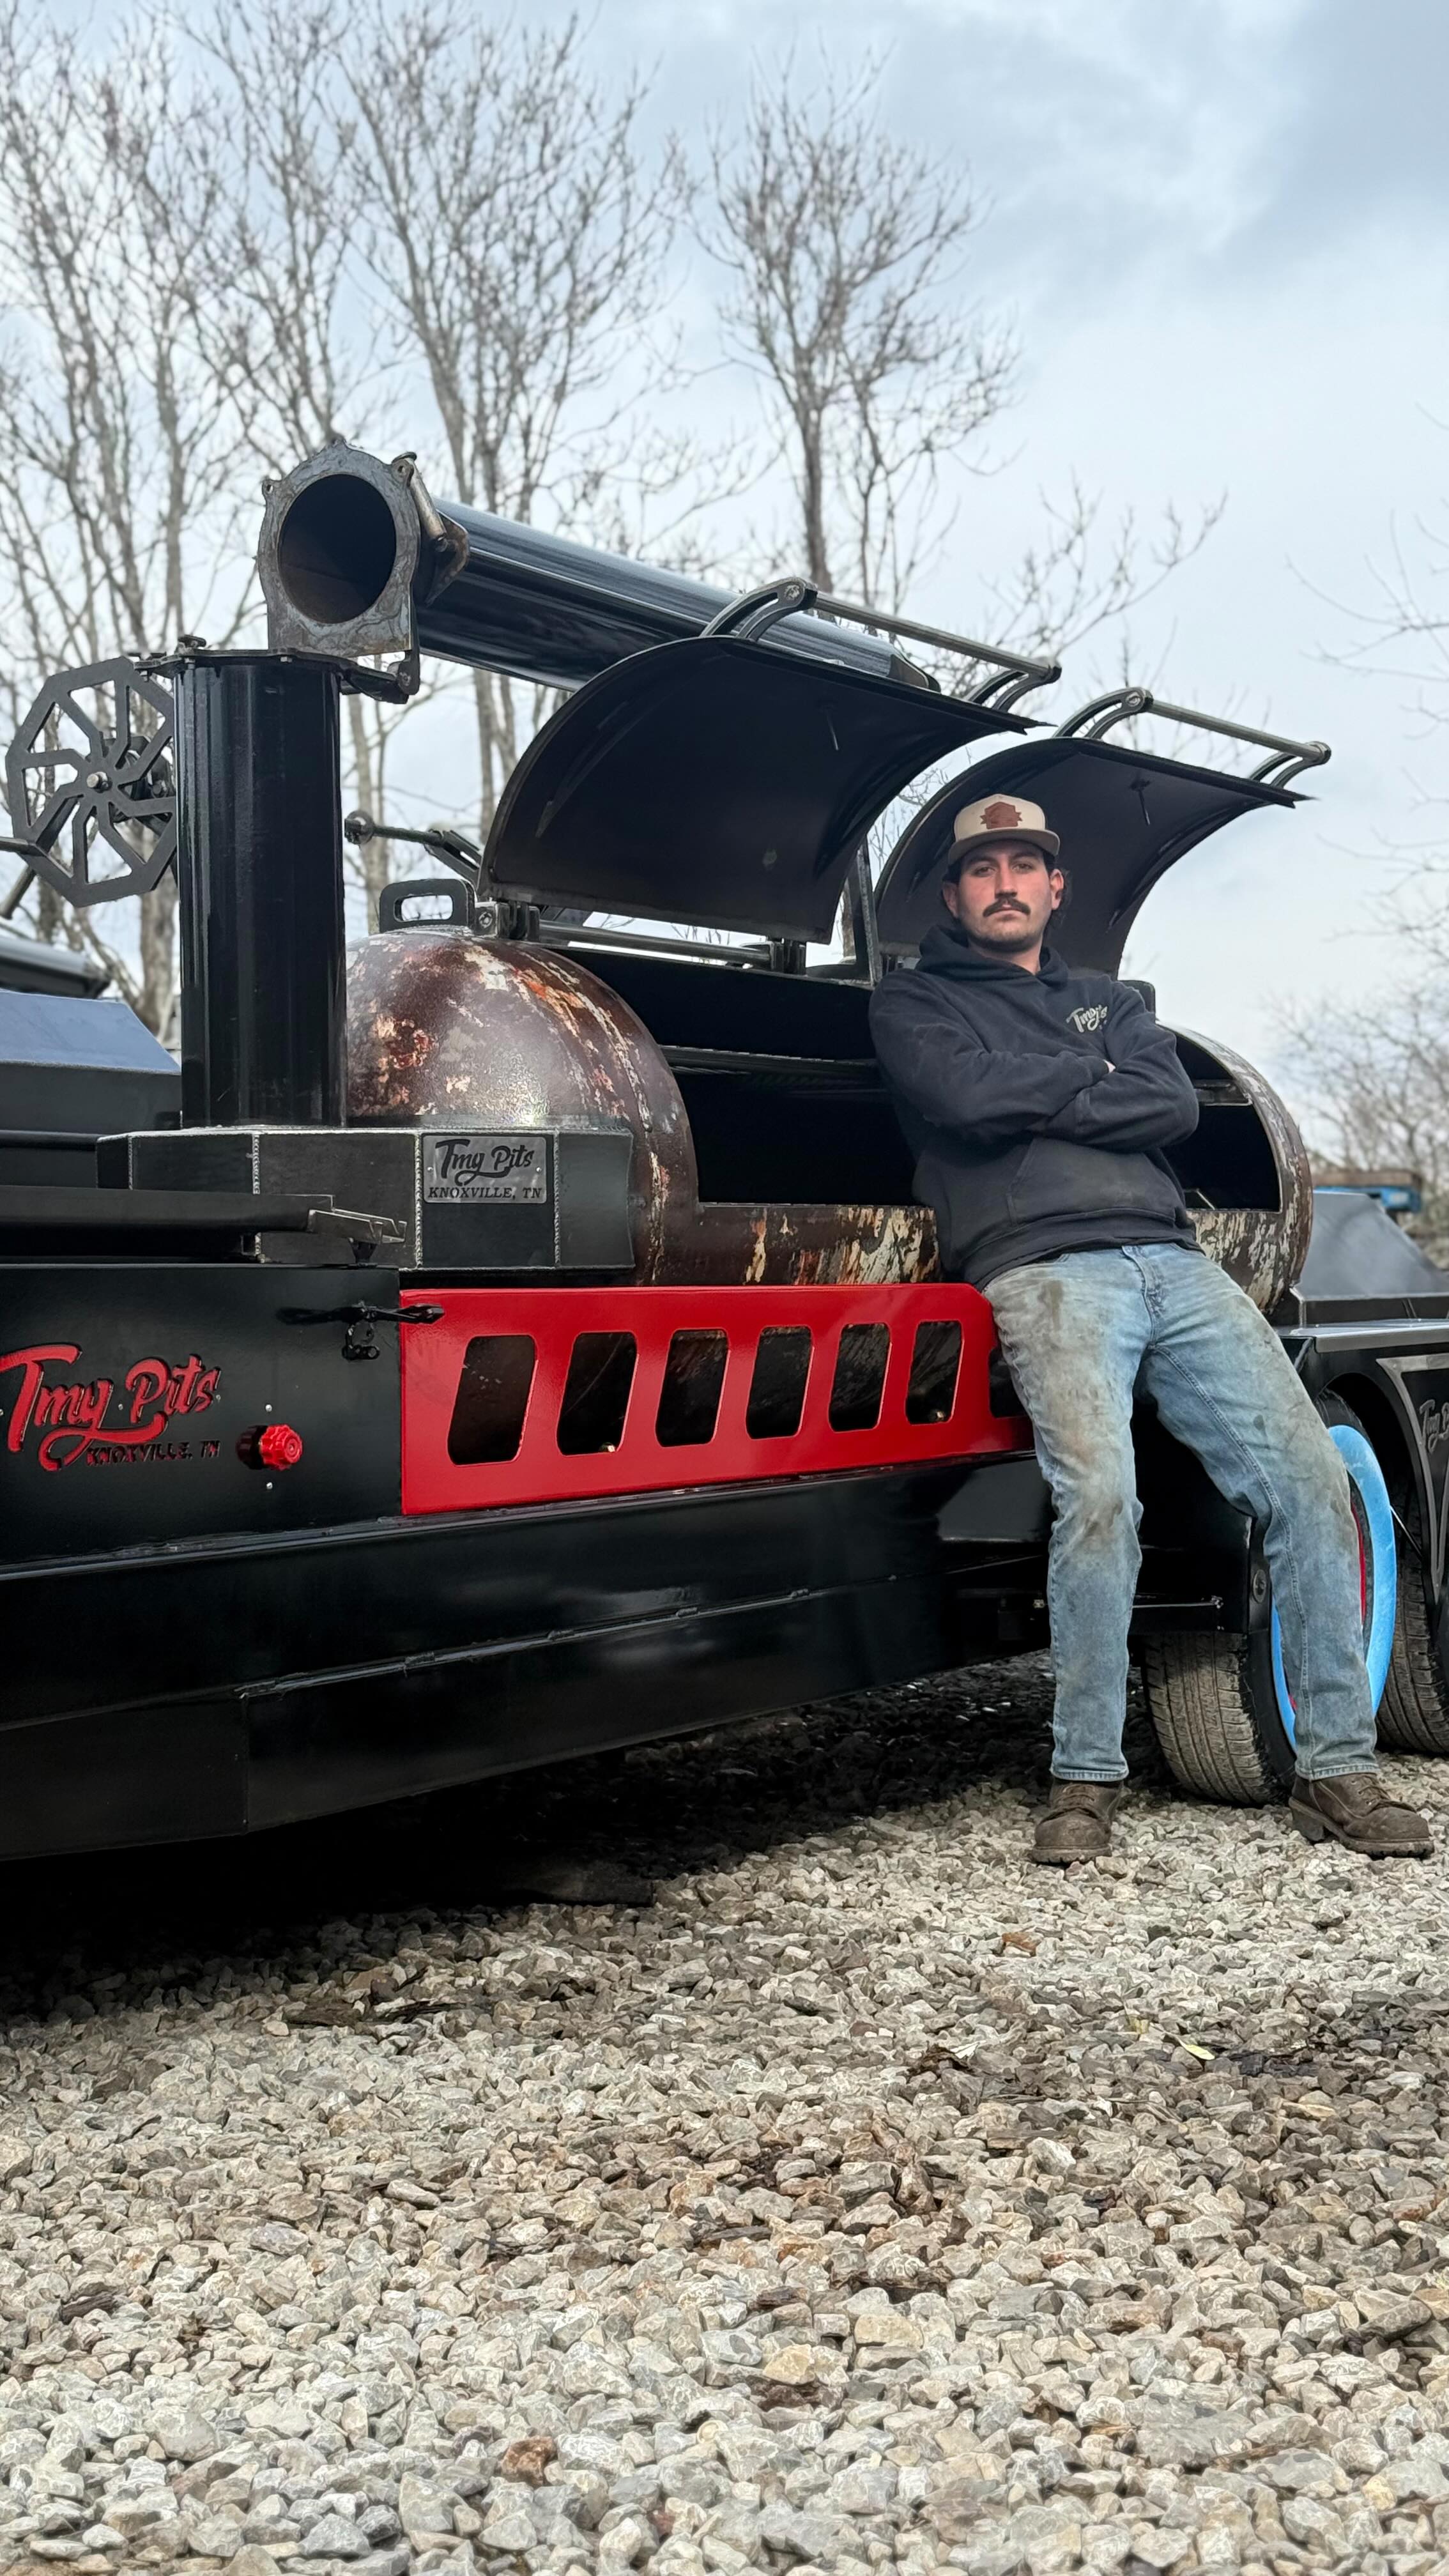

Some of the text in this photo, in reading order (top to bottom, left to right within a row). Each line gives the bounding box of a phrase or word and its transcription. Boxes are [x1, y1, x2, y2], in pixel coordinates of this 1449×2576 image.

[491, 1145, 534, 1171] Pits
[428, 1187, 542, 1200] KNOXVILLE, TN
[125, 1353, 221, 1424] Pits
[199, 1440, 220, 1459] TN
